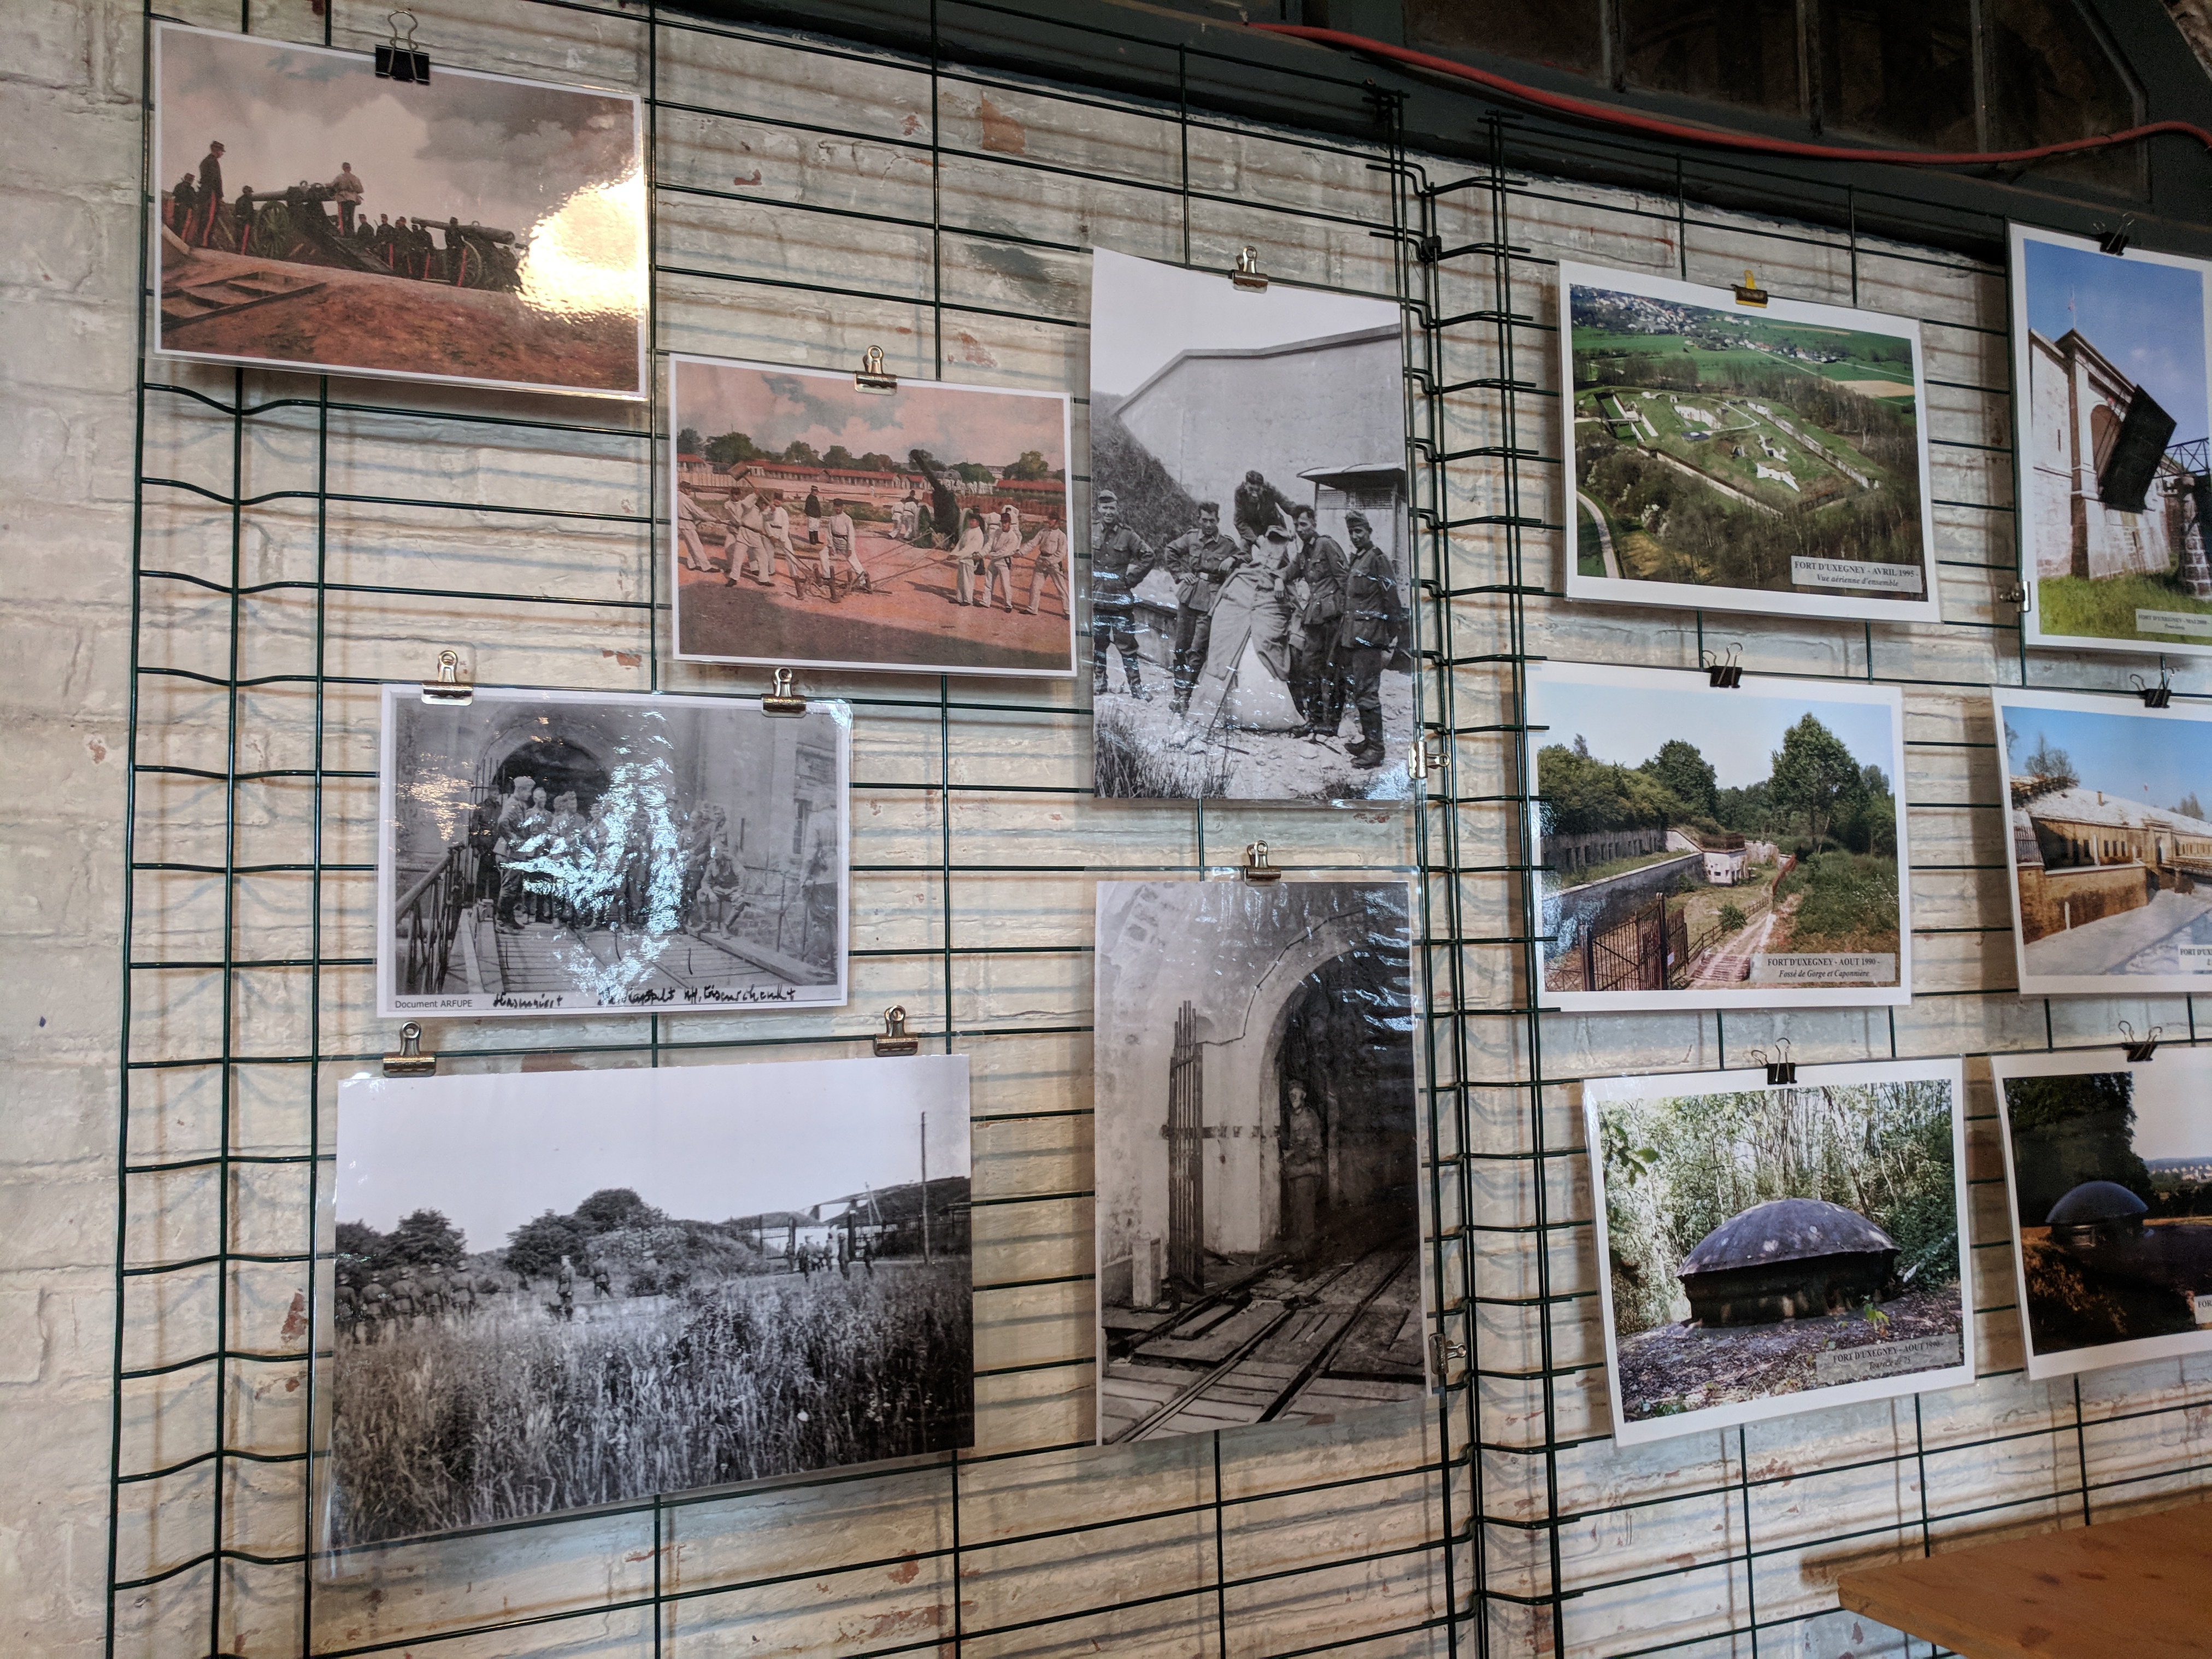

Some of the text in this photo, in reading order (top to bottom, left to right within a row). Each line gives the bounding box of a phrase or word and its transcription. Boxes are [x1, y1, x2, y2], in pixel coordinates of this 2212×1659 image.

[1795, 561, 1816, 570] FORT
[1819, 563, 1865, 574] D'UXEGNEY
[1873, 568, 1896, 576] AVRIL
[1817, 574, 1899, 587] Vue aérienne d'ensemble
[1768, 958, 1789, 966] FORT
[1807, 969, 1825, 979] Gorge
[1834, 969, 1870, 979] Caponnière
[440, 999, 473, 1008] ARFUPE
[1833, 1353, 1853, 1363] FORT
[1854, 1346, 1898, 1360] D'UXEGNEY
[1904, 1343, 1925, 1353] AOUT
[1903, 1356, 1911, 1364] 75
